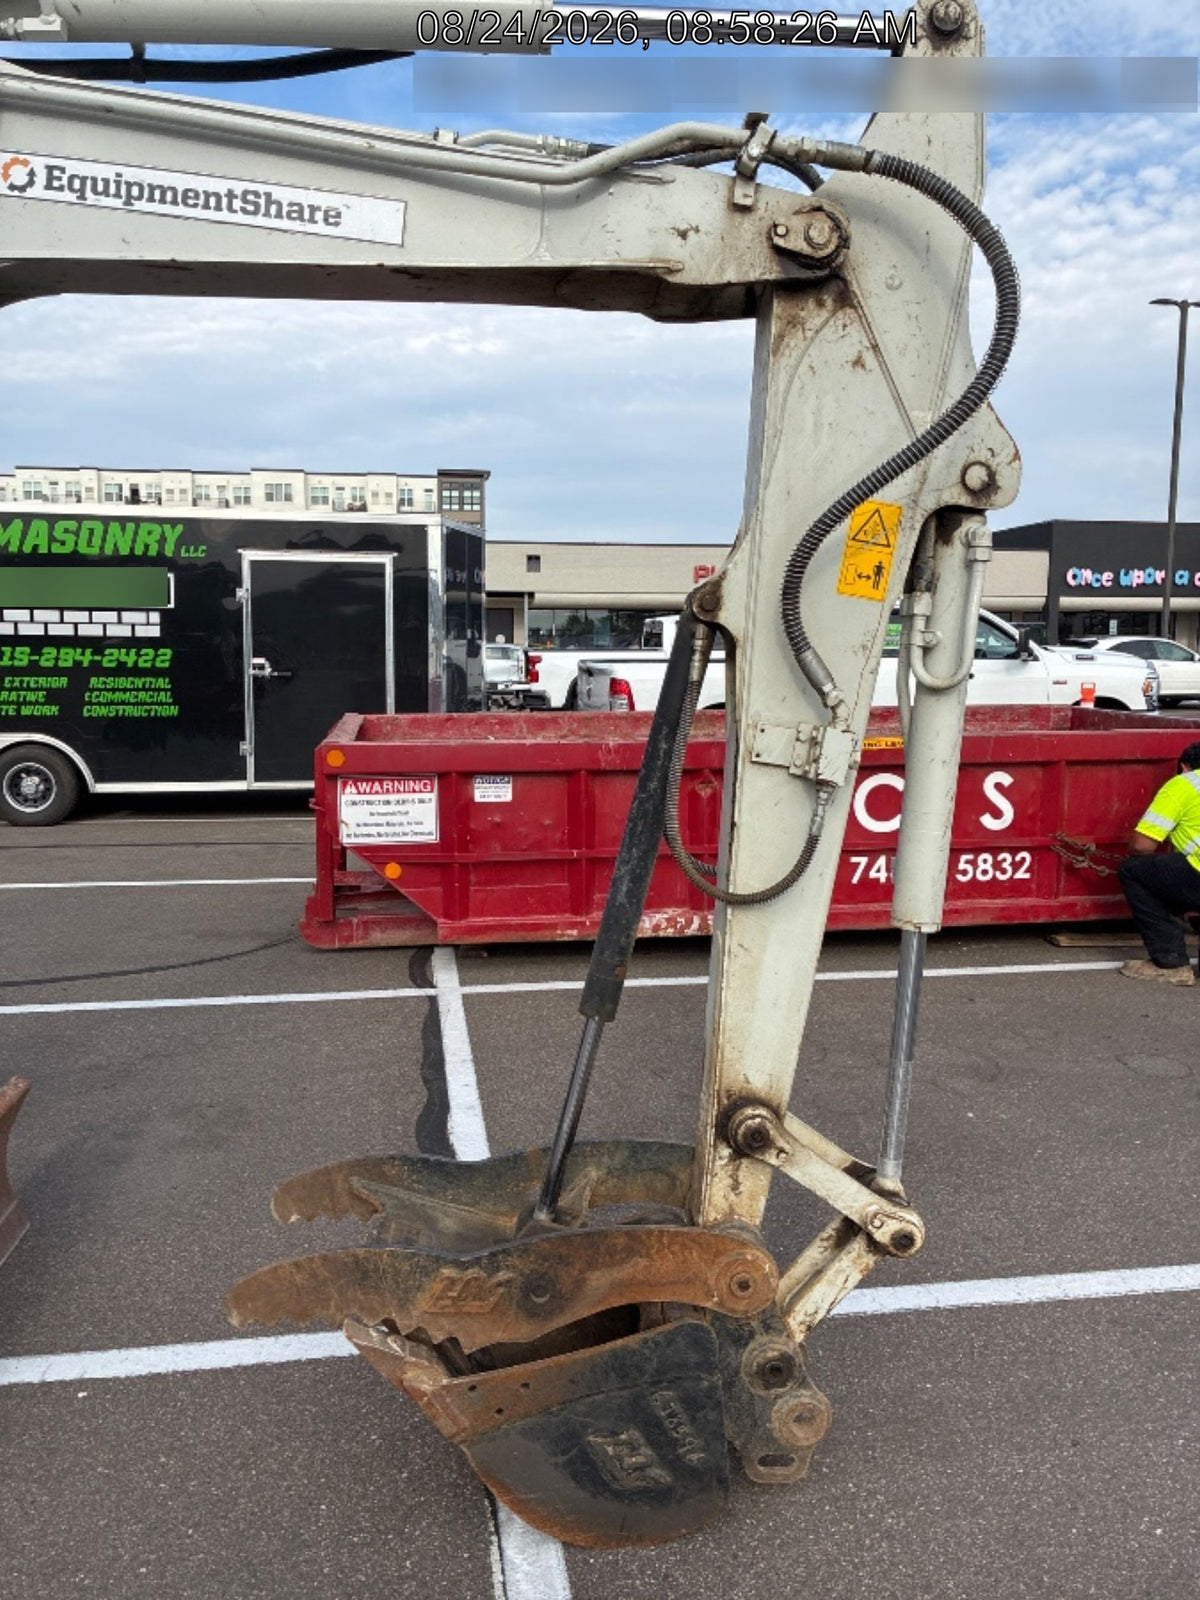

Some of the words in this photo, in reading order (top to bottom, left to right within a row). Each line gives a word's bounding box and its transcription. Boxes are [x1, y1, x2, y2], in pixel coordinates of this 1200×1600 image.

[43, 164, 342, 228] EquipmentShare
[0, 518, 183, 557] MASONRY
[1174, 569, 1190, 586] a
[4, 676, 68, 689] EXTERIOR
[89, 676, 171, 688] RESIDENTIAL
[20, 705, 59, 717] WORK
[83, 705, 179, 717] CONSTRUCTION
[357, 780, 431, 794] WARNING
